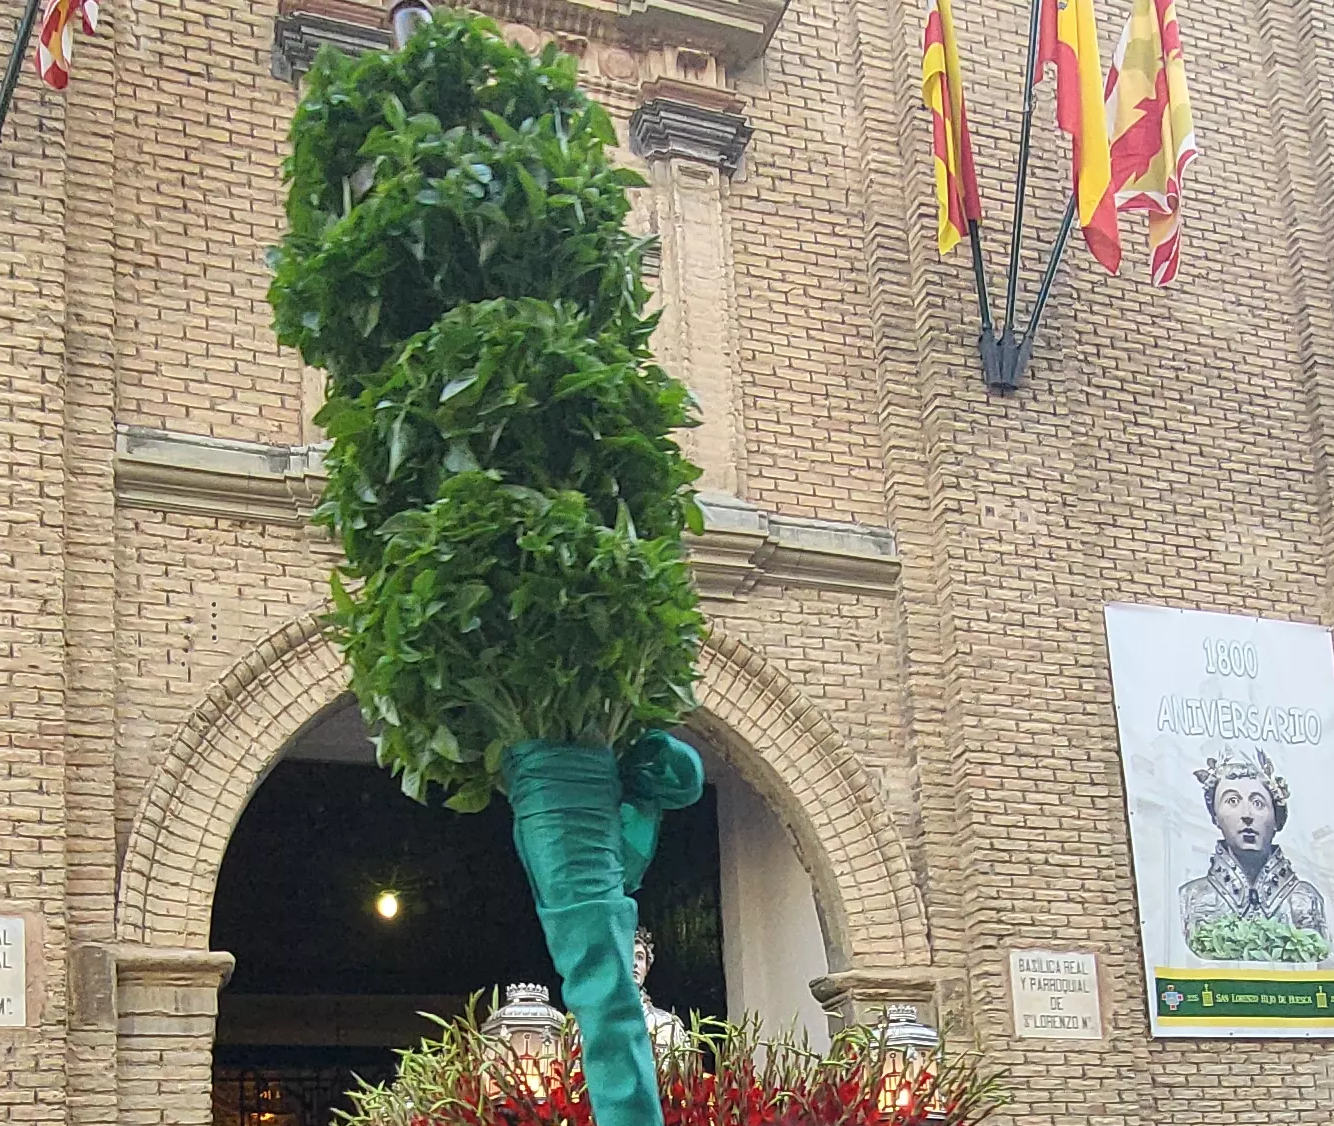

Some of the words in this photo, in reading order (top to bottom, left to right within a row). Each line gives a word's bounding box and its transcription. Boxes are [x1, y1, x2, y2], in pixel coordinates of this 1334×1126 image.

[1203, 637, 1259, 679] 1800
[1157, 694, 1322, 745] ANIVERSARIO
[1064, 960, 1089, 975] REAL
[1020, 977, 1027, 990] Y
[1030, 978, 1090, 994] PARROQUIAL
[1050, 997, 1064, 1010] DE
[1215, 994, 1229, 1003] SAN
[1278, 994, 1287, 1004] DE
[1288, 995, 1313, 1004] HUESCA
[1034, 1014, 1079, 1029] LORENZO
